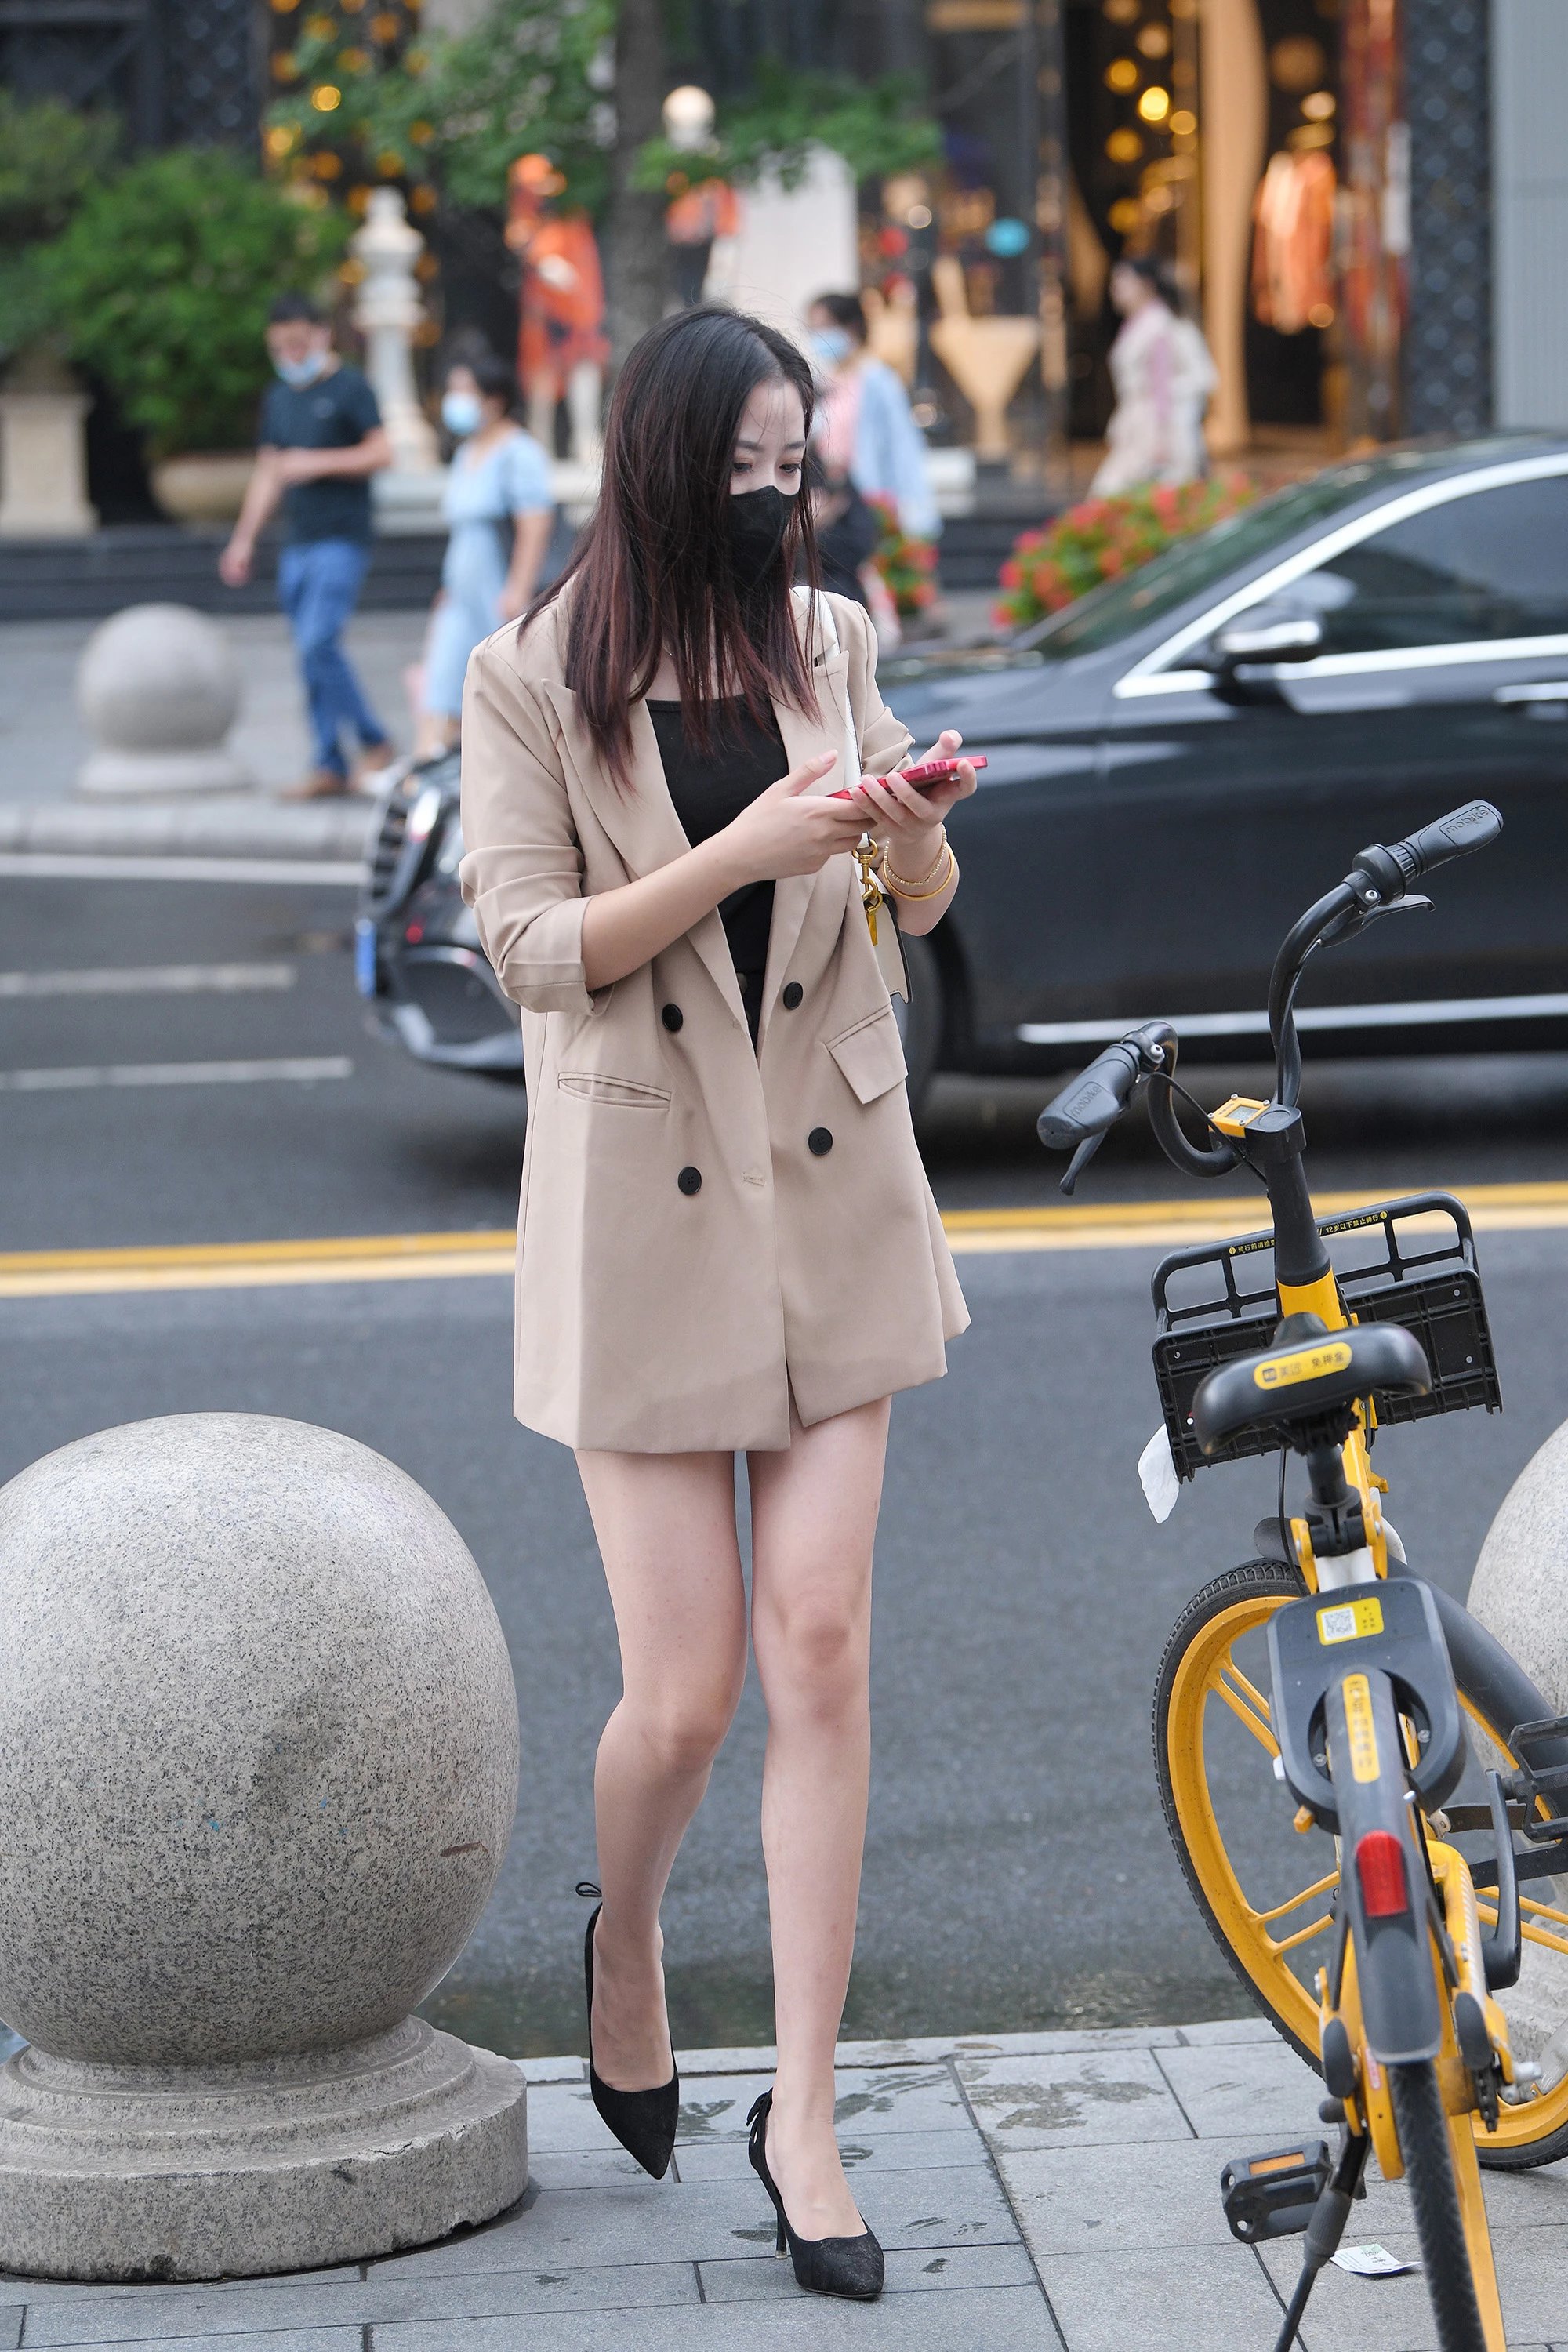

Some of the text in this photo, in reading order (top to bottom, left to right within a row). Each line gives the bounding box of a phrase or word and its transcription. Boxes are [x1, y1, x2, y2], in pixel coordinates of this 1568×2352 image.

[1446, 808, 1488, 834] mobike
[1325, 1214, 1379, 1234] 12岁以下禁止骑行
